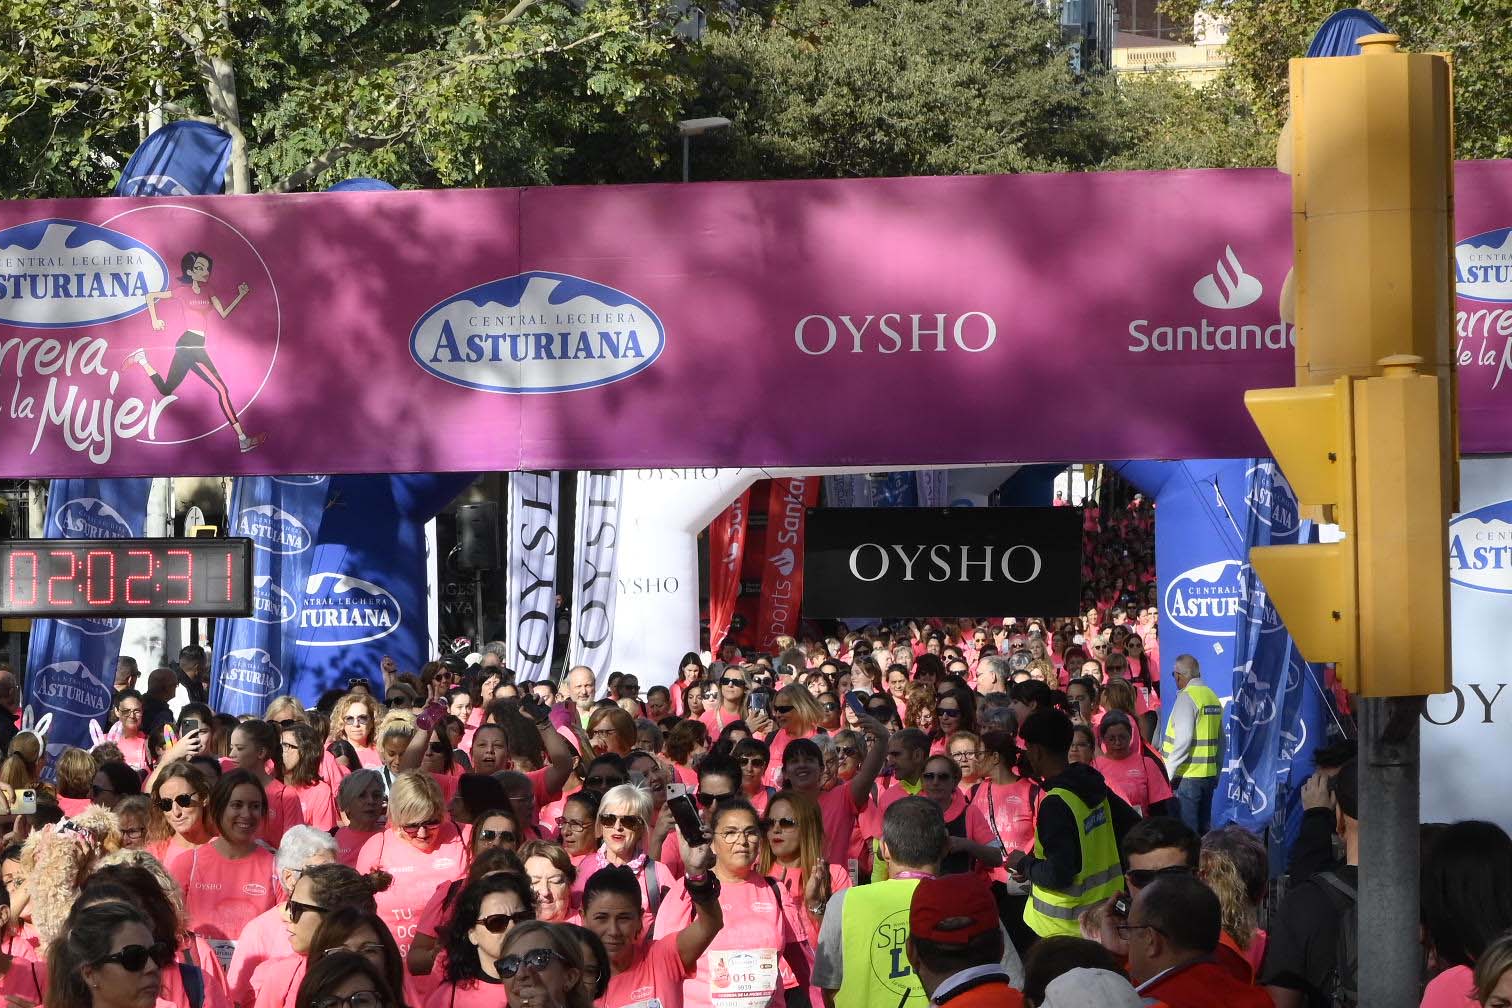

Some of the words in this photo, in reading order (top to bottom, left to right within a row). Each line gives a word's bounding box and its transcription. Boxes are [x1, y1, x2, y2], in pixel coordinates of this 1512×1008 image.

[72, 255, 144, 266] LECHERA
[469, 314, 548, 326] CENTRAL
[555, 313, 637, 325] LECHERA
[429, 318, 645, 364] ASTURIANA
[794, 311, 998, 355] OYSHO
[1128, 319, 1295, 353] Santand
[1479, 338, 1496, 366] la
[10, 377, 34, 419] la
[29, 371, 179, 465] Mujer
[848, 543, 1042, 584] OYSHO
[9, 551, 232, 604] 02:02:31
[618, 576, 680, 595] YSHO
[1188, 586, 1238, 595] CENTRAL
[338, 598, 387, 606] LECHERA
[299, 607, 392, 628] TURIANA
[195, 882, 223, 891] OYSHO
[391, 908, 412, 920] TU
[732, 974, 756, 982] 016
